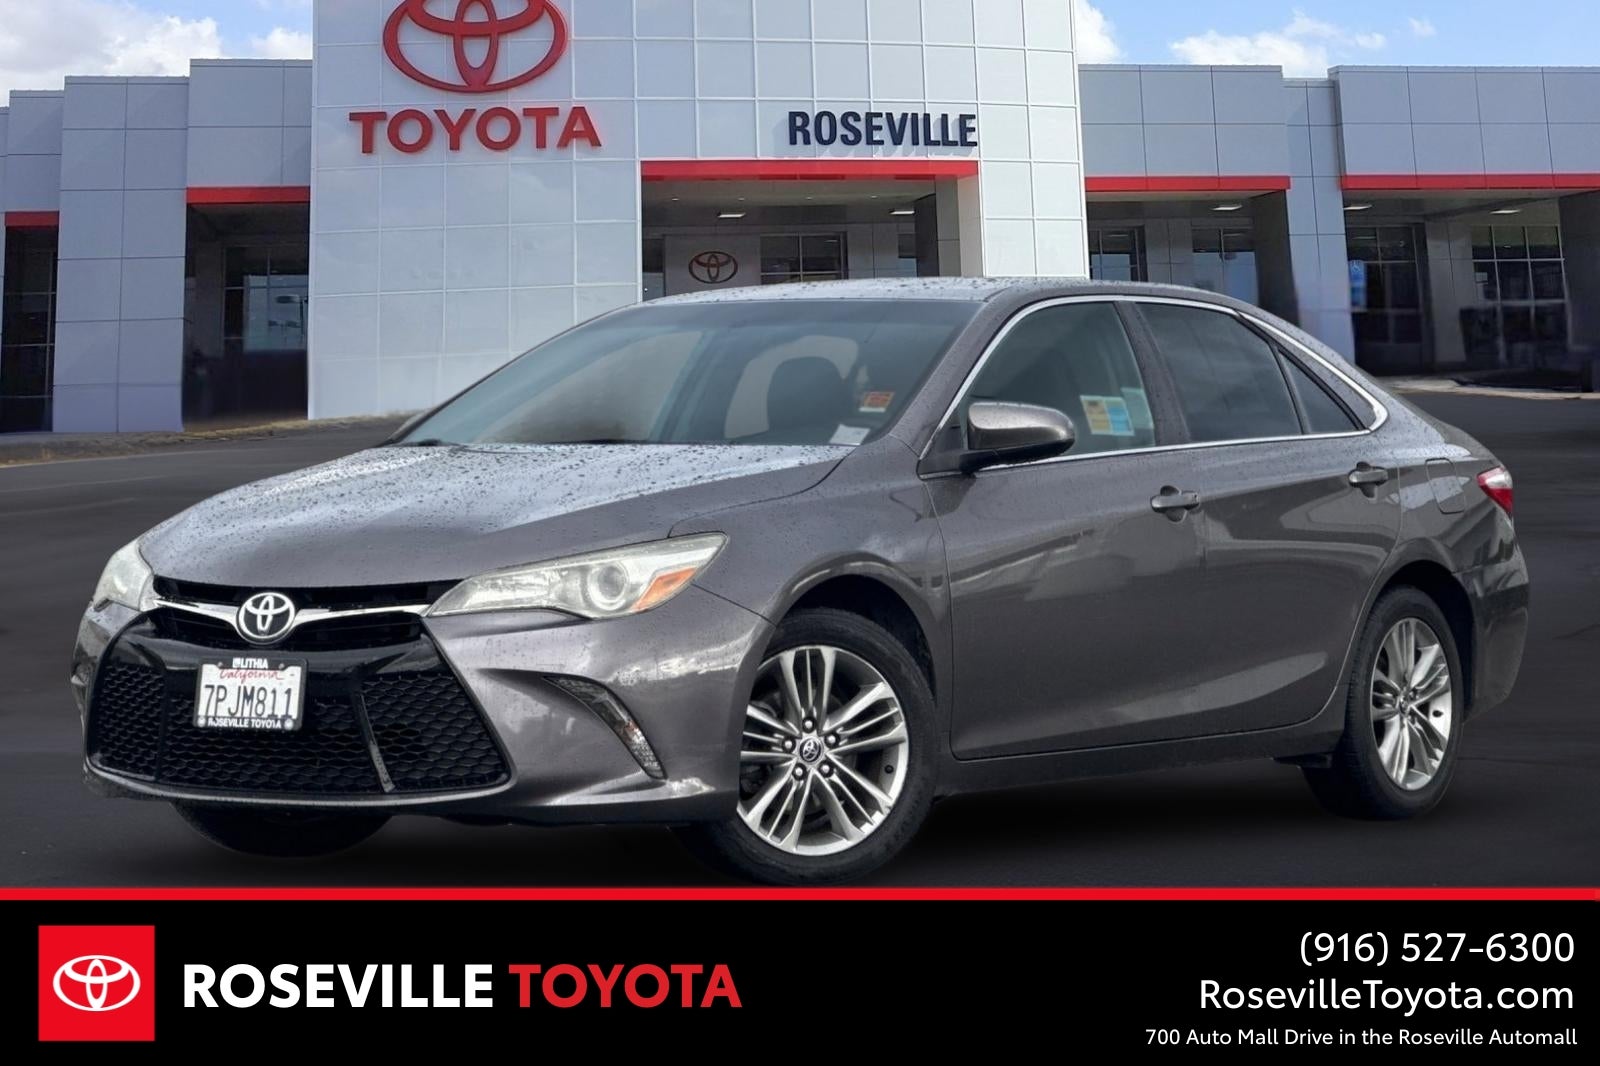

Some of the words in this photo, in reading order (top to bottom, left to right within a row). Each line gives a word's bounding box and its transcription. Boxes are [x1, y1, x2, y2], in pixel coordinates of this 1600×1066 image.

[348, 106, 602, 153] TOYOTA
[788, 110, 978, 147] ROSEVILLE
[240, 657, 269, 669] LITHIA
[219, 668, 284, 684] California
[203, 684, 293, 719] 7PJM811
[251, 718, 282, 729] TOYOTA
